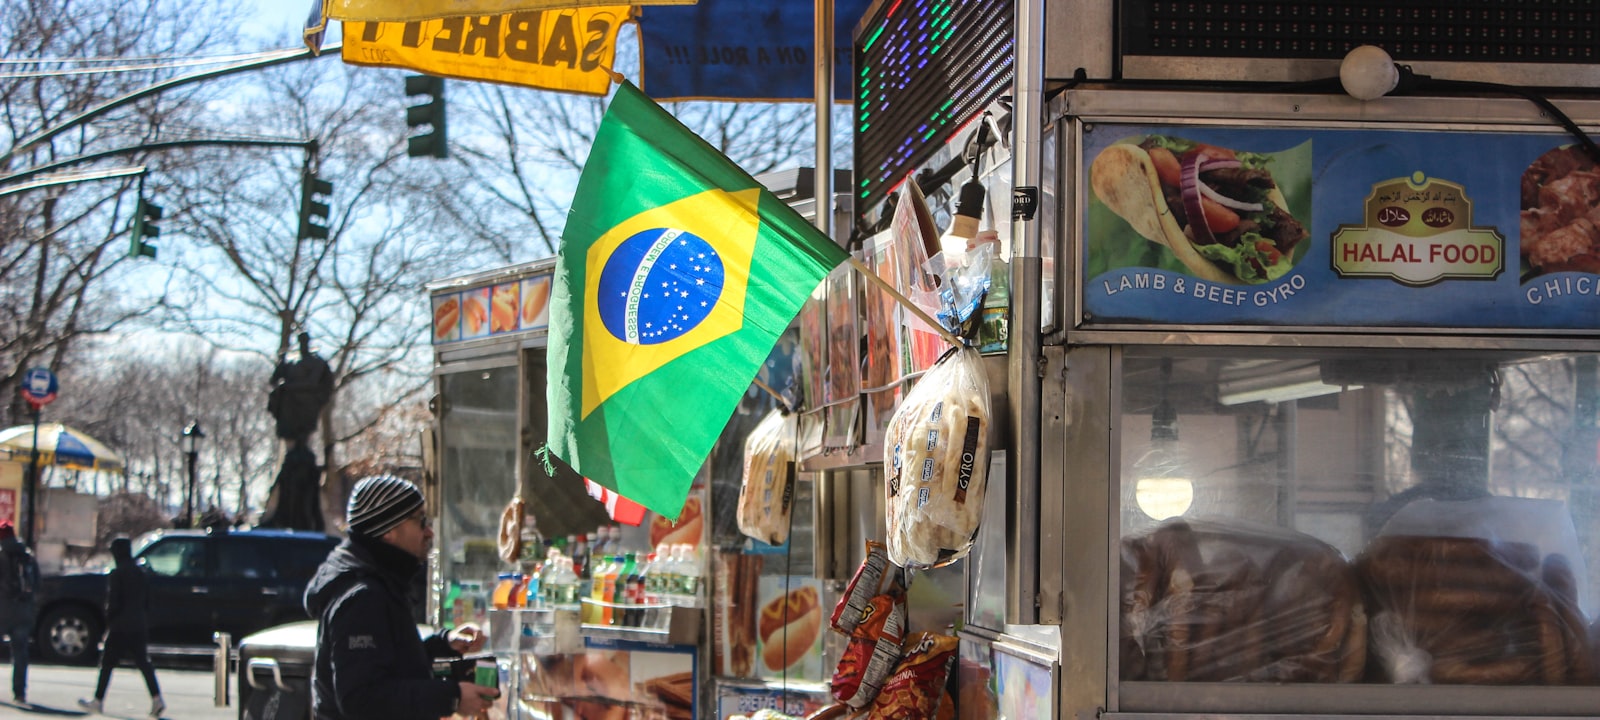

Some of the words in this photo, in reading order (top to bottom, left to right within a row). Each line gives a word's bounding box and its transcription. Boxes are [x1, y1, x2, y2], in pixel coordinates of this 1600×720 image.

[1379, 208, 1409, 223] حلال
[1343, 243, 1422, 263] HALAL
[1430, 244, 1496, 264] FOOD
[1104, 273, 1166, 296] LAMB
[1173, 278, 1186, 294] &
[1193, 282, 1248, 306] BEEF
[1253, 274, 1306, 307] GYRO
[959, 452, 974, 490] GYRO
